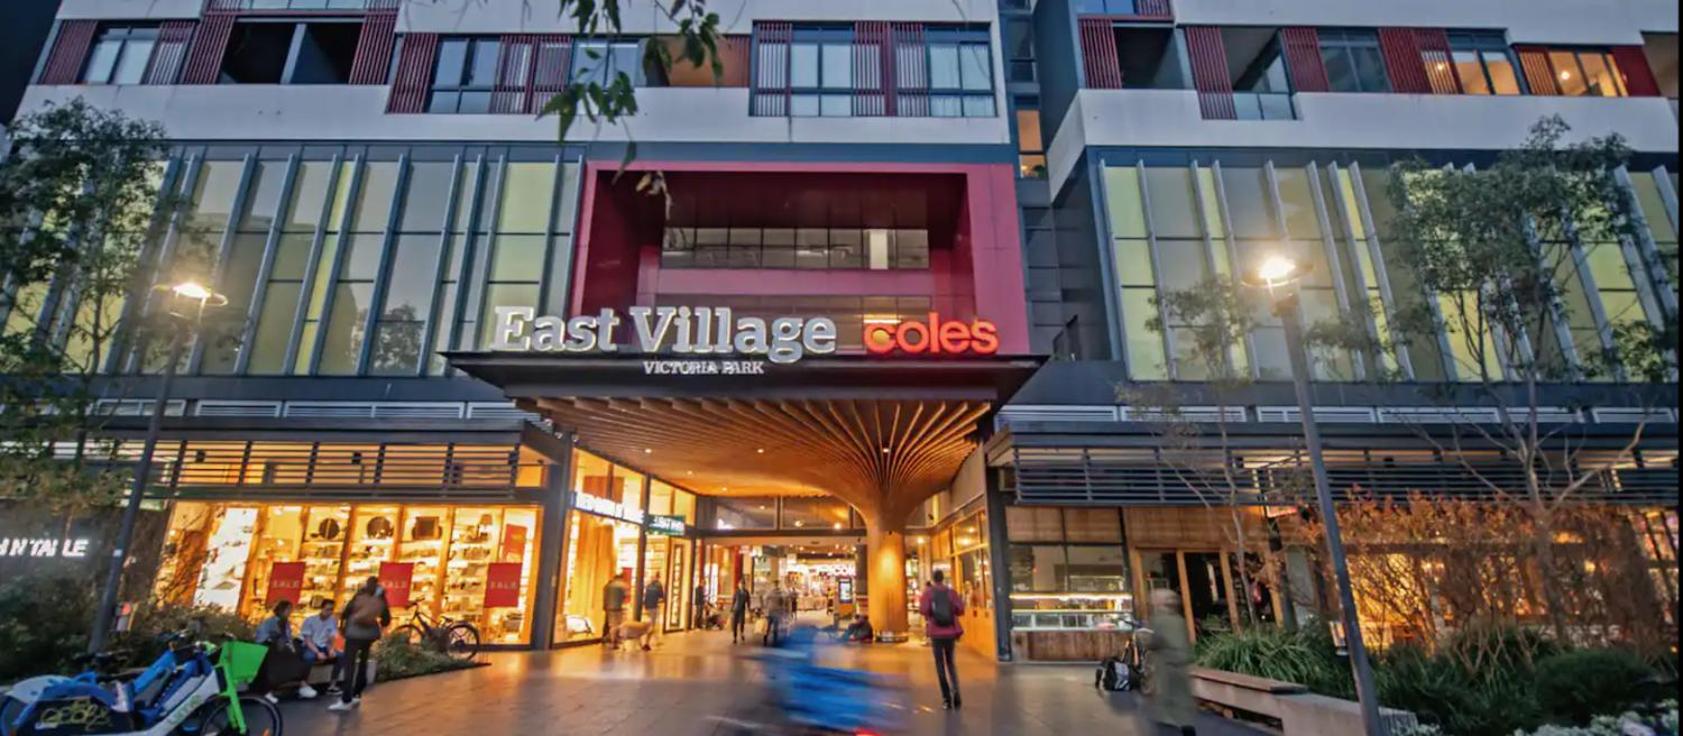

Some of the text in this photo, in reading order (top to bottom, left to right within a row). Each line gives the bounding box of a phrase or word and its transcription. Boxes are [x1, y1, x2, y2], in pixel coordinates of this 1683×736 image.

[488, 305, 838, 363] East Village
[863, 312, 999, 354] coles
[642, 360, 765, 375] VICTORIA PARK
